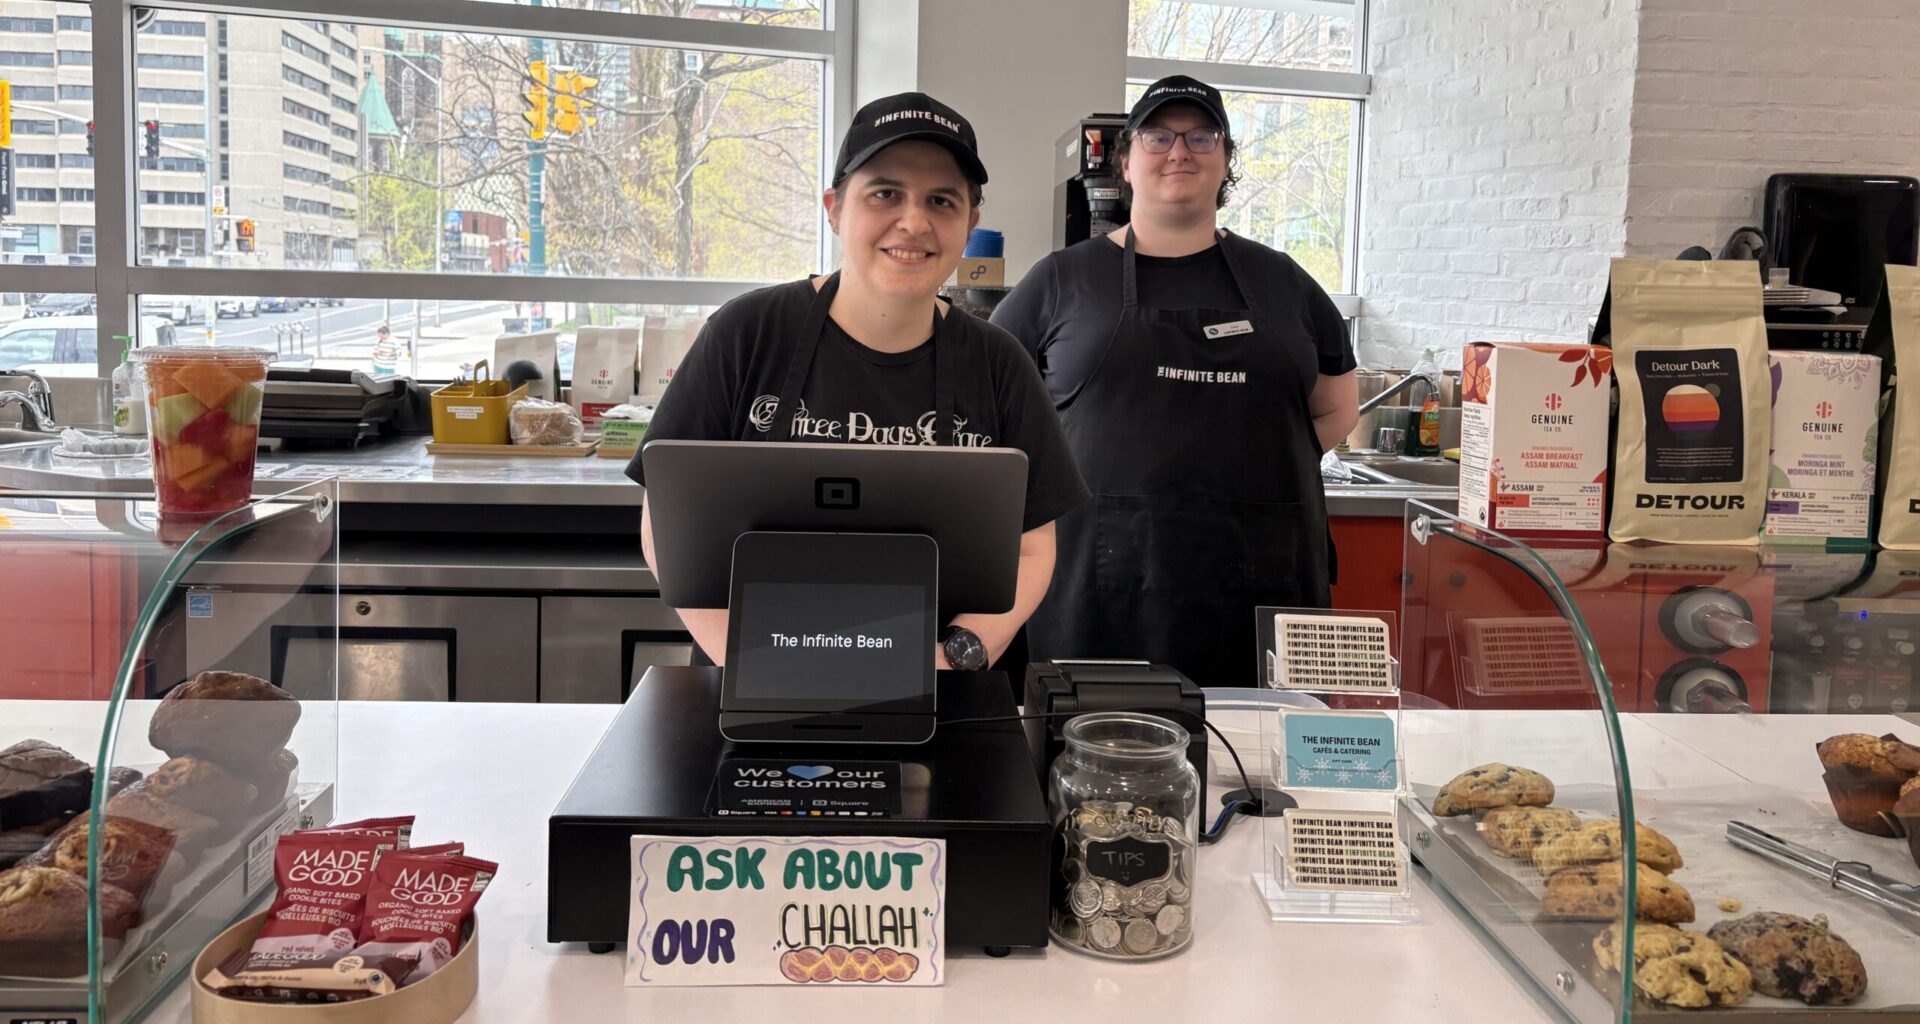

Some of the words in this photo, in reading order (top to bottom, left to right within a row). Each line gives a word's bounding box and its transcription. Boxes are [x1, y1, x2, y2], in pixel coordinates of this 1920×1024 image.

[882, 110, 932, 124] INFINITE
[934, 114, 959, 133] BEAN
[1652, 362, 1688, 371] Detour
[1691, 360, 1720, 370] Dark
[1165, 367, 1214, 382] INFINITE
[1217, 371, 1246, 383] BEAN
[1531, 414, 1573, 425] GENUINE
[847, 412, 917, 446] Days
[1802, 423, 1843, 432] GENUINE
[1521, 452, 1544, 460] ASSAM
[1546, 453, 1583, 461] BREAKFAST
[1798, 460, 1828, 468] MORINGA
[1787, 468, 1817, 476] MORINGA
[1636, 494, 1745, 510] DETOUR
[771, 633, 798, 647] The
[803, 634, 852, 648] Infinite
[857, 635, 893, 648] Bean
[1302, 736, 1318, 744] THE
[1320, 737, 1356, 745] INFINITE
[1358, 738, 1380, 746] BEAN
[737, 768, 783, 778] We
[837, 770, 884, 778] our
[734, 779, 886, 789] customers
[1102, 851, 1145, 867] TIPS
[1350, 849, 1376, 857] INFINITE
[293, 849, 370, 871] MADE
[667, 845, 767, 892] ASK
[783, 848, 923, 891] ABOUT
[288, 864, 362, 887] GOOD
[394, 867, 470, 893] MADE
[1352, 878, 1379, 886] INFINITE
[289, 894, 318, 903] COOKIE
[335, 892, 360, 900] BAKED
[390, 887, 463, 906] GOOD
[378, 902, 413, 911] ORGANIC
[276, 911, 326, 922] OELLEUSES
[328, 917, 340, 926] BIO
[322, 908, 355, 922] BISCUITS
[424, 920, 456, 933] BISCUITS
[431, 925, 443, 934] BIO
[652, 919, 735, 965] OUR
[781, 903, 918, 949] CHALLAH
